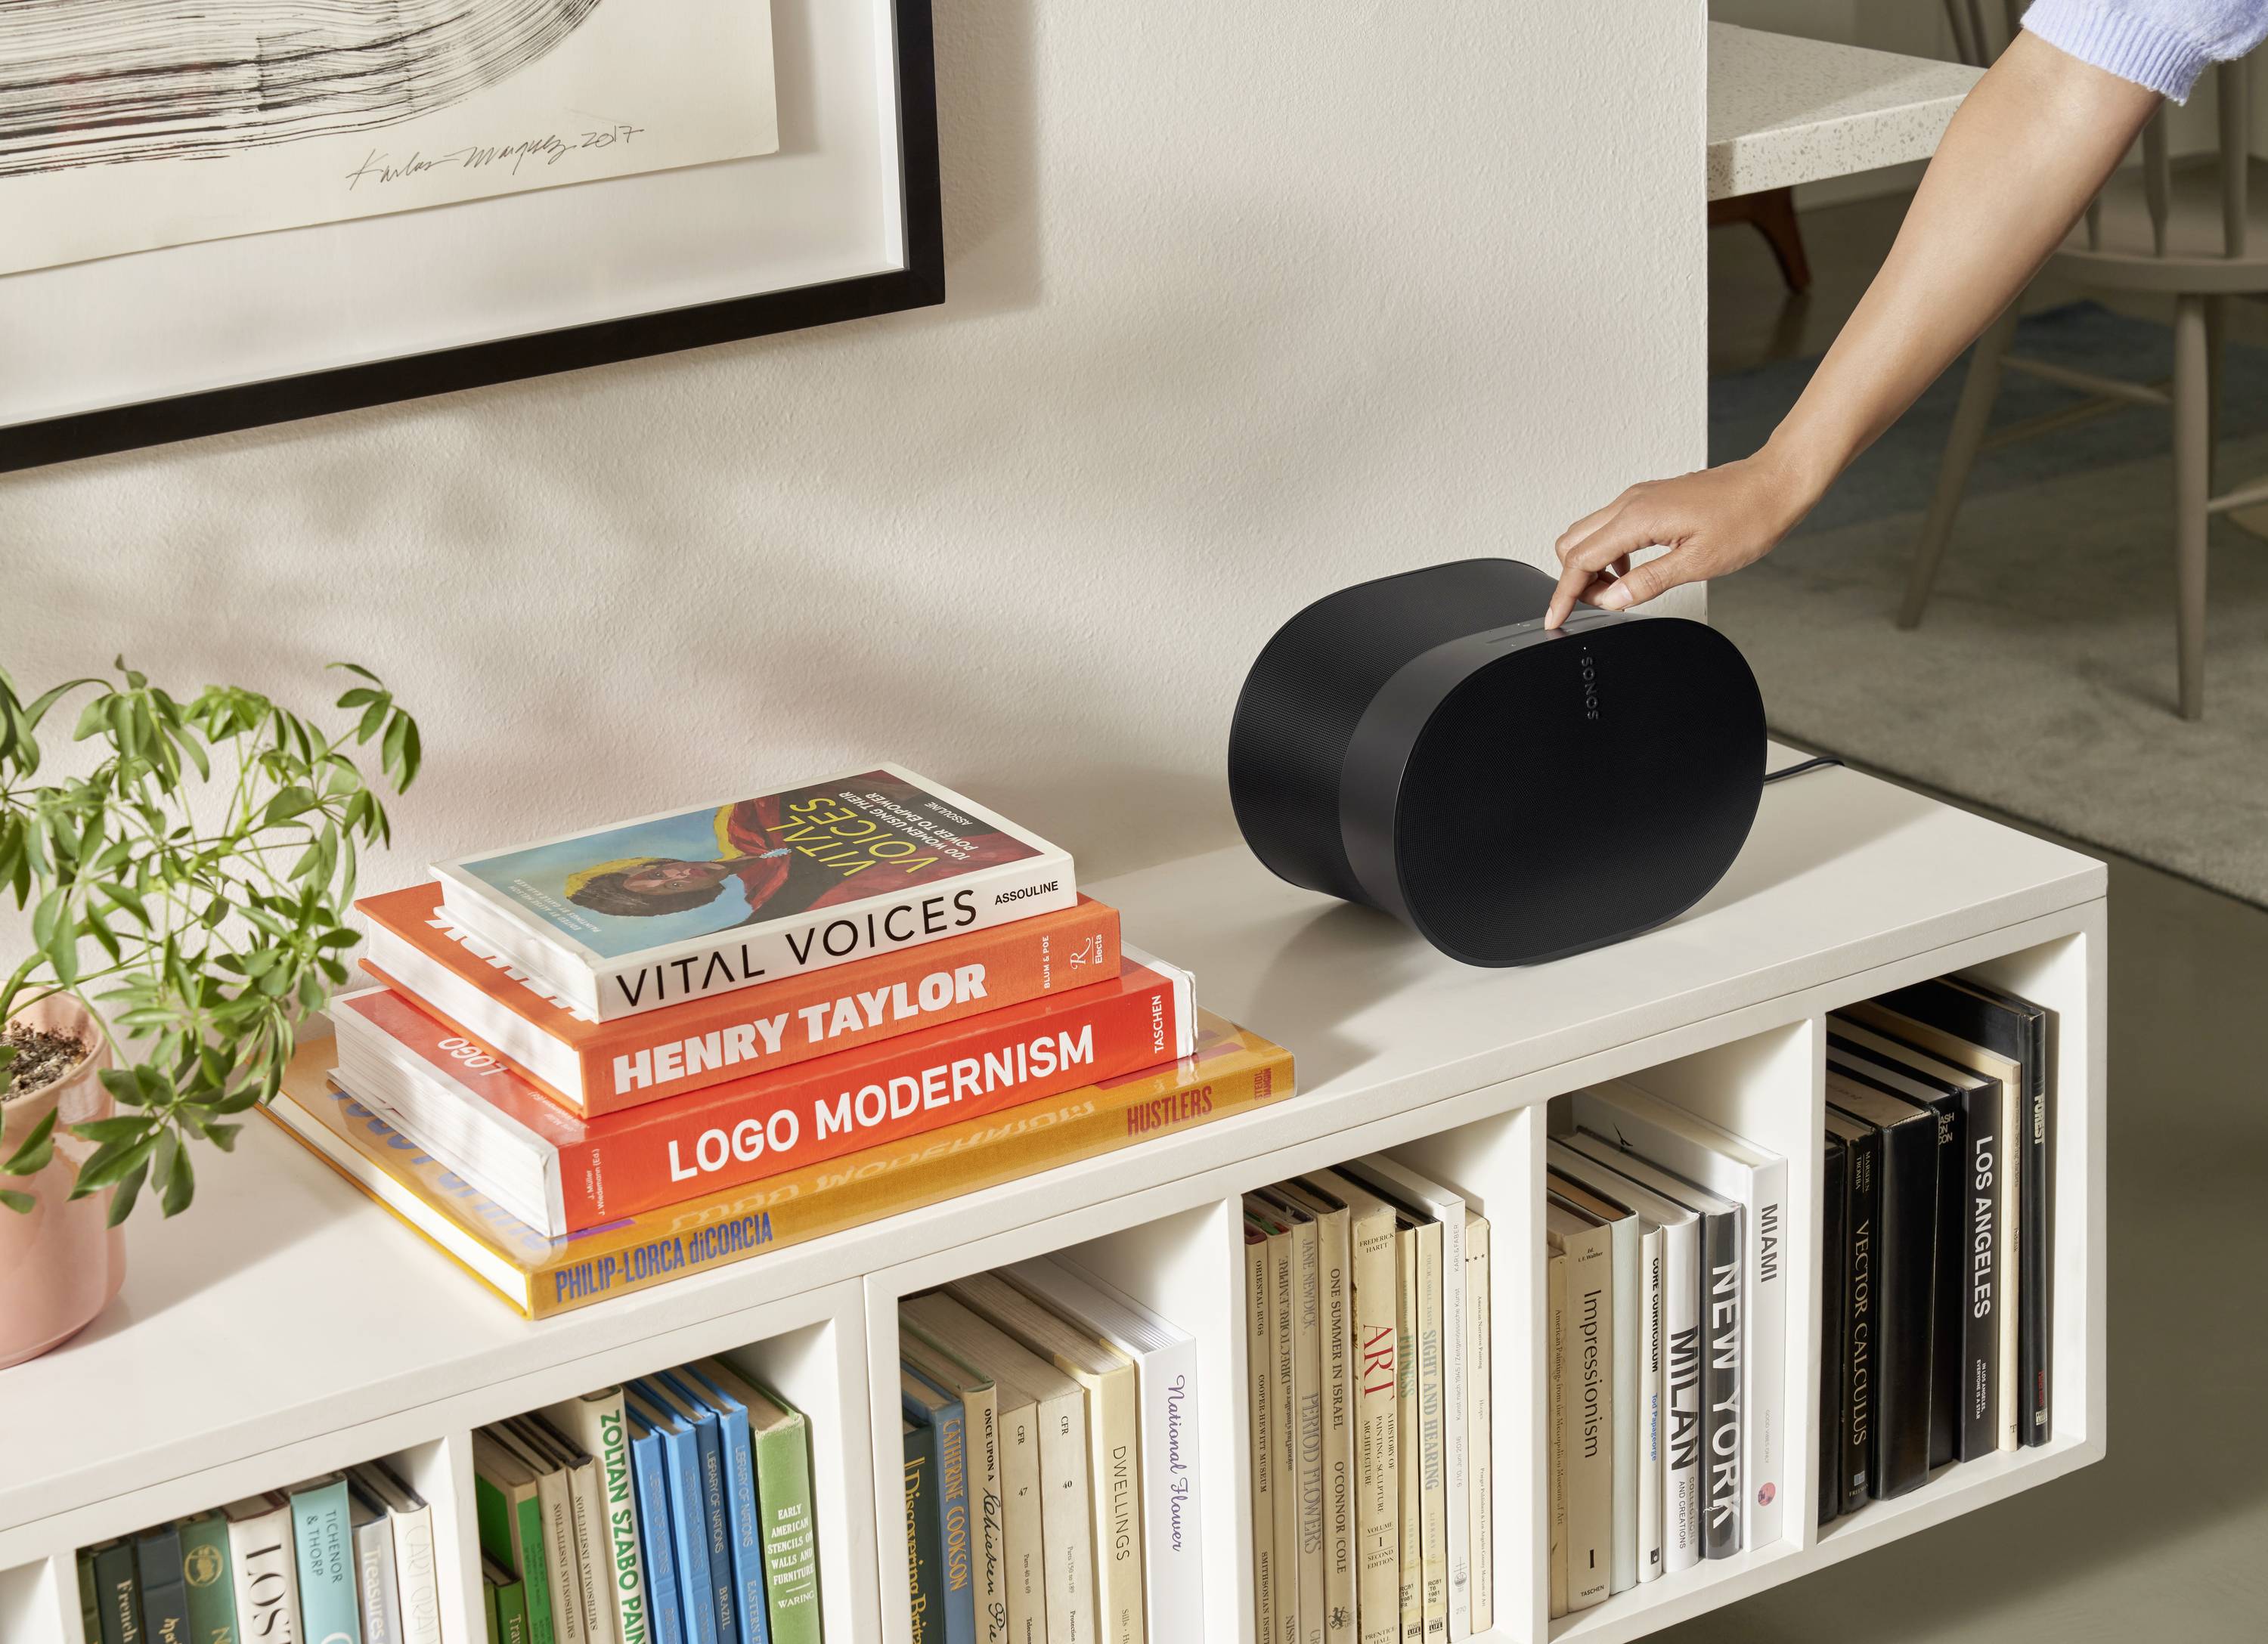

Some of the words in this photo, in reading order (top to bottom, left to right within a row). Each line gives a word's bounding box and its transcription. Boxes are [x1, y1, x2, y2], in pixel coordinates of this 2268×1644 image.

[581, 125, 644, 148] 2017
[1582, 656, 1599, 720] SONOS
[838, 791, 872, 810] THEIR
[865, 792, 924, 824] EMPOWER
[870, 809, 909, 832] USING
[925, 801, 973, 825] ASSOULINE
[765, 815, 876, 877] VITAL
[789, 797, 940, 873] VOICES
[907, 827, 947, 850] WOMEN
[917, 820, 941, 833] TO
[938, 829, 979, 851] POWER
[944, 847, 971, 860] 100
[616, 943, 765, 1008] VITAL
[785, 889, 978, 966] VOICES
[994, 880, 1059, 906] ASSOULINE
[1095, 933, 1103, 965] Electa
[612, 1013, 789, 1095] HENRY
[798, 963, 987, 1044] TAYLOR
[1154, 995, 1163, 1054] TASCHEN
[438, 1037, 510, 1077] LOGO
[668, 1110, 800, 1182] LOGO
[814, 1023, 1094, 1140] MODERNISM
[1127, 1085, 1213, 1137] HUSTLERS
[1975, 1135, 1993, 1190] LOS
[596, 1165, 605, 1209] Wiedemann
[556, 1235, 685, 1303] PHILIP-LORCA
[689, 1212, 773, 1265] diCORCIA
[1303, 1239, 1314, 1271] JANE
[1359, 1233, 1394, 1248] FREDERICK
[1366, 1242, 1388, 1253] HARTT
[1761, 1203, 1778, 1283] MIAMI
[1974, 1197, 1992, 1318] ANGELES
[1255, 1260, 1263, 1308] ORIENTAL
[1278, 1255, 1290, 1305] EMPIRE
[1331, 1268, 1340, 1298] ONE
[1854, 1219, 1869, 1318] VECTOR
[1331, 1301, 1342, 1361] SUMMER
[1712, 1260, 1741, 1369] NEW
[1331, 1363, 1342, 1380] IN
[1363, 1324, 1395, 1402] ART
[1399, 1335, 1414, 1398] FITNESS
[1423, 1330, 1437, 1377] SIGHT
[1579, 1290, 1603, 1459] Impressionism
[1332, 1382, 1344, 1431] ISRAEL
[1424, 1383, 1438, 1416] AND
[1671, 1325, 1698, 1470] MILAN
[1854, 1323, 1867, 1446] CALCULUS
[1061, 1415, 1069, 1436] CFR
[1168, 1374, 1187, 1475] National
[1258, 1374, 1266, 1453] COOPER-HEWITT
[1302, 1392, 1320, 1463] PERIOD
[600, 1409, 629, 1504] ZOLTAN
[706, 1450, 719, 1493] LIBRARY
[735, 1445, 748, 1486] LIBRARY
[943, 1419, 963, 1503] CATHERINE
[985, 1440, 994, 1473] UPON
[987, 1474, 994, 1482] A
[1389, 1458, 1394, 1469] OF
[1424, 1419, 1439, 1491] HEARING
[1712, 1384, 1740, 1529] YORK
[710, 1494, 720, 1506] OF
[739, 1488, 749, 1501] OF
[1018, 1486, 1028, 1497] 47
[1062, 1479, 1073, 1490] 40
[1113, 1445, 1130, 1561] DWELLINGS
[1334, 1461, 1346, 1534] O'CONNOR
[307, 1515, 319, 1525] &
[575, 1496, 590, 1559] INSTITUTION
[712, 1509, 724, 1554] NATIONS
[740, 1503, 753, 1548] NATIONS
[771, 1516, 809, 1538] AMERICAN
[778, 1503, 802, 1520] EARLY
[1170, 1476, 1189, 1553] Flower
[1303, 1466, 1322, 1555] FLOWERS
[1367, 1522, 1393, 1535] VOLUME
[308, 1528, 324, 1577] THORP
[325, 1509, 343, 1584] TICHENOR
[553, 1503, 568, 1567] INSTITUTION
[612, 1509, 639, 1591] SZABO
[768, 1536, 804, 1554] STENCILS
[771, 1554, 798, 1570] WALLS
[800, 1547, 813, 1562] AND
[946, 1506, 968, 1592] COOKSON
[983, 1486, 1002, 1596] Chicken
[1368, 1550, 1393, 1562] SECOND
[773, 1562, 814, 1586] FURNITURE
[1024, 1570, 1031, 1578] 40
[1367, 1558, 1394, 1570] EDITION
[116, 1579, 139, 1643] French
[364, 1544, 385, 1641] Treasures
[561, 1570, 575, 1639] SMITHSONIAN
[582, 1562, 598, 1631] SMITHSONIAN
[720, 1587, 732, 1630] BRAZIL
[747, 1580, 761, 1633] EASTERN
[778, 1590, 814, 1609] WARING
[1581, 1584, 1604, 1597] TASCHEN
[1122, 1608, 1130, 1627] Sills
